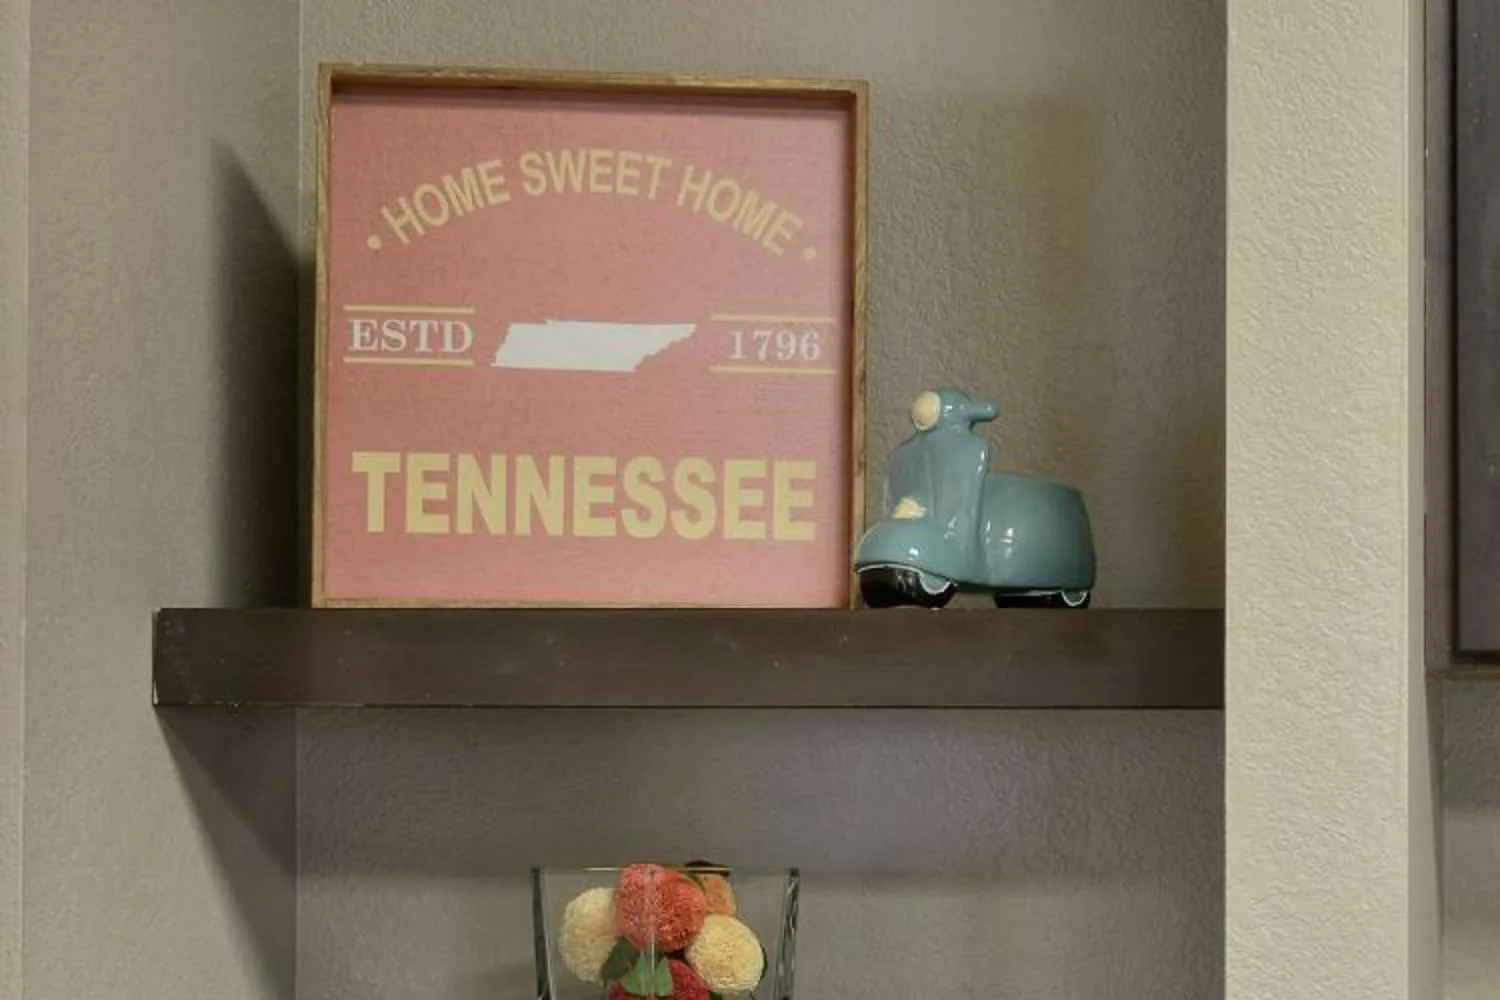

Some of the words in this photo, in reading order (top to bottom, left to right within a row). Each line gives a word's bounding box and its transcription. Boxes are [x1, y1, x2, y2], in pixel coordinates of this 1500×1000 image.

[380, 157, 511, 245] HOME
[519, 148, 673, 201] SWEET
[677, 164, 804, 257] HOME
[348, 319, 474, 354] ESTD
[729, 329, 822, 361] 1796
[350, 450, 818, 542] TENNESSEE
